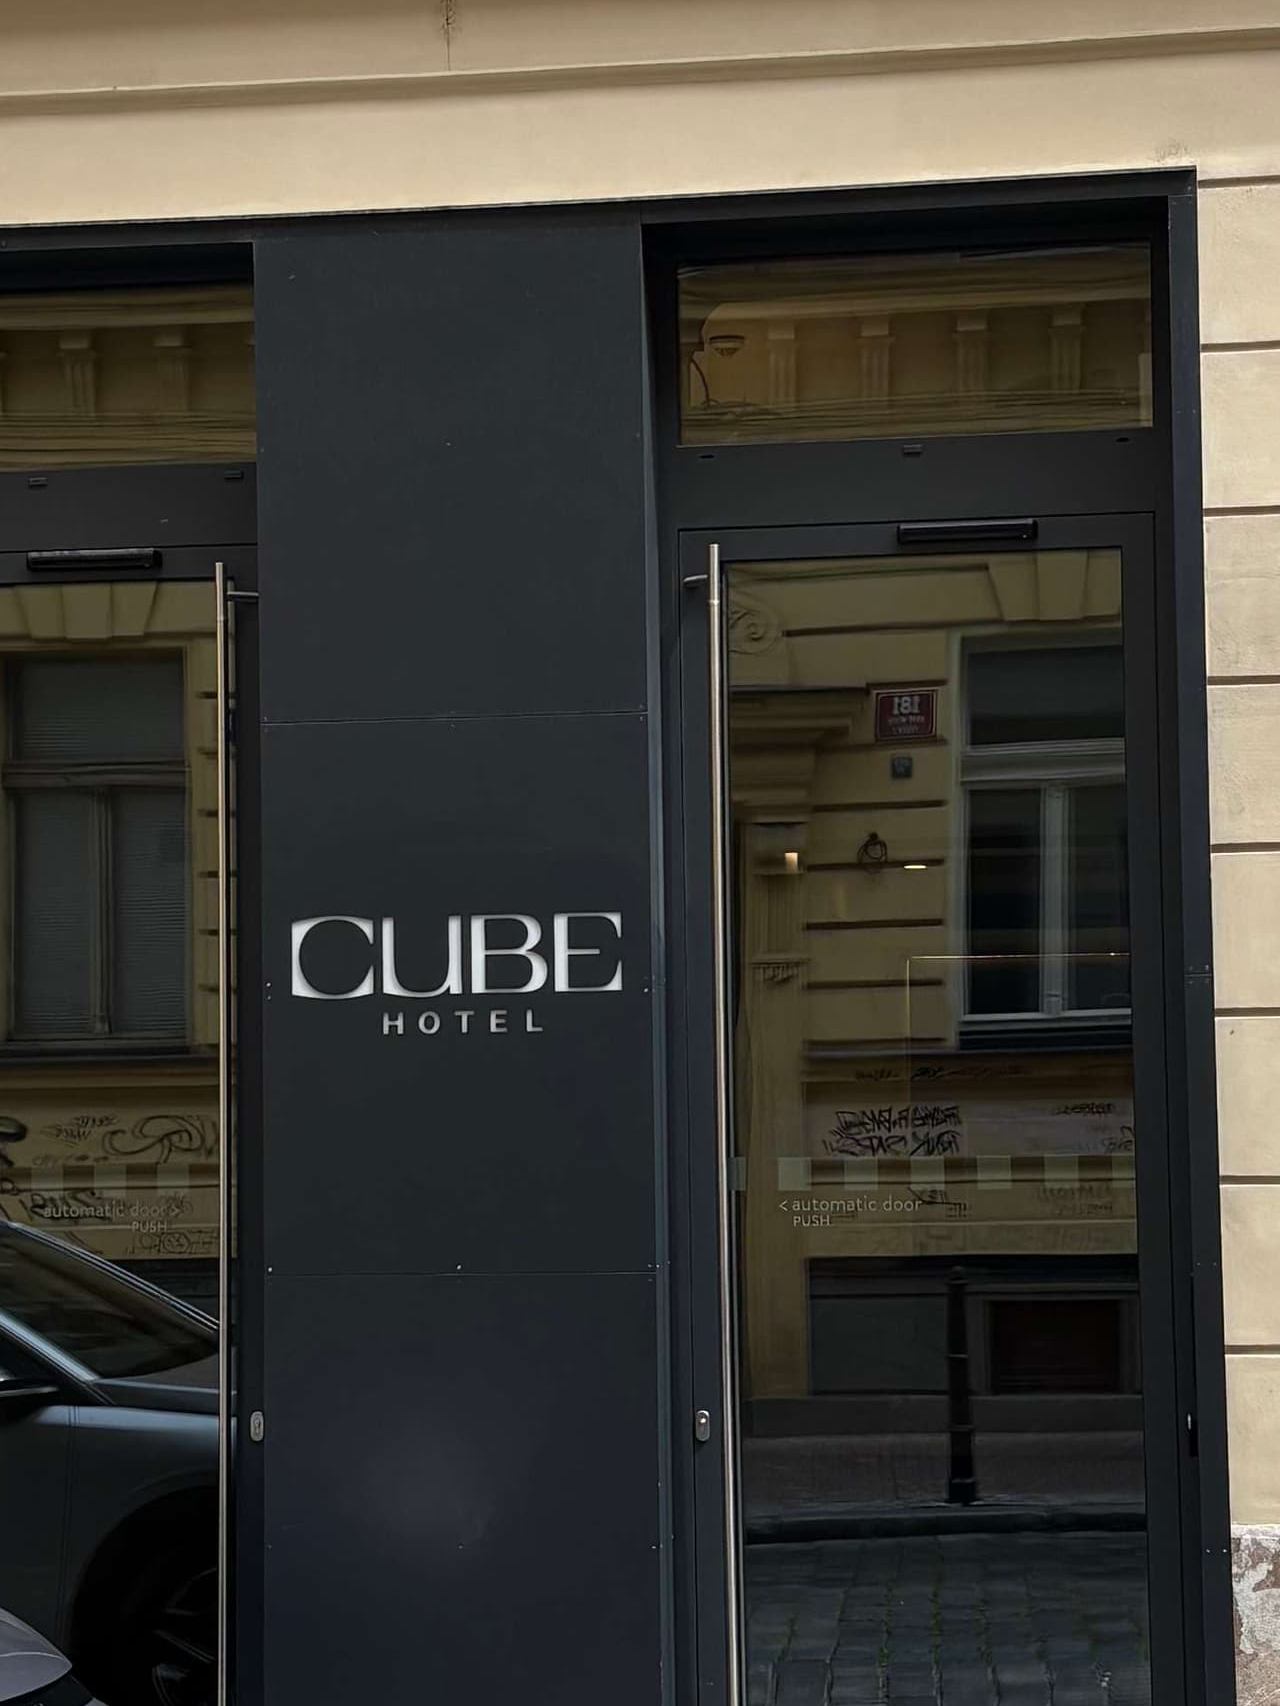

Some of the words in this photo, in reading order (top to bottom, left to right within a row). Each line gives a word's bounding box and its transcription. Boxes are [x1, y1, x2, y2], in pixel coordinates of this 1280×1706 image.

[291, 911, 623, 1000] CUBE
[382, 1009, 544, 1035] HOTEL
[44, 1201, 125, 1218] automatic
[130, 1201, 167, 1217] door
[791, 1195, 877, 1212] automatic
[883, 1194, 922, 1212] door
[132, 1220, 168, 1233] PUSH
[793, 1214, 831, 1227] PUSH
